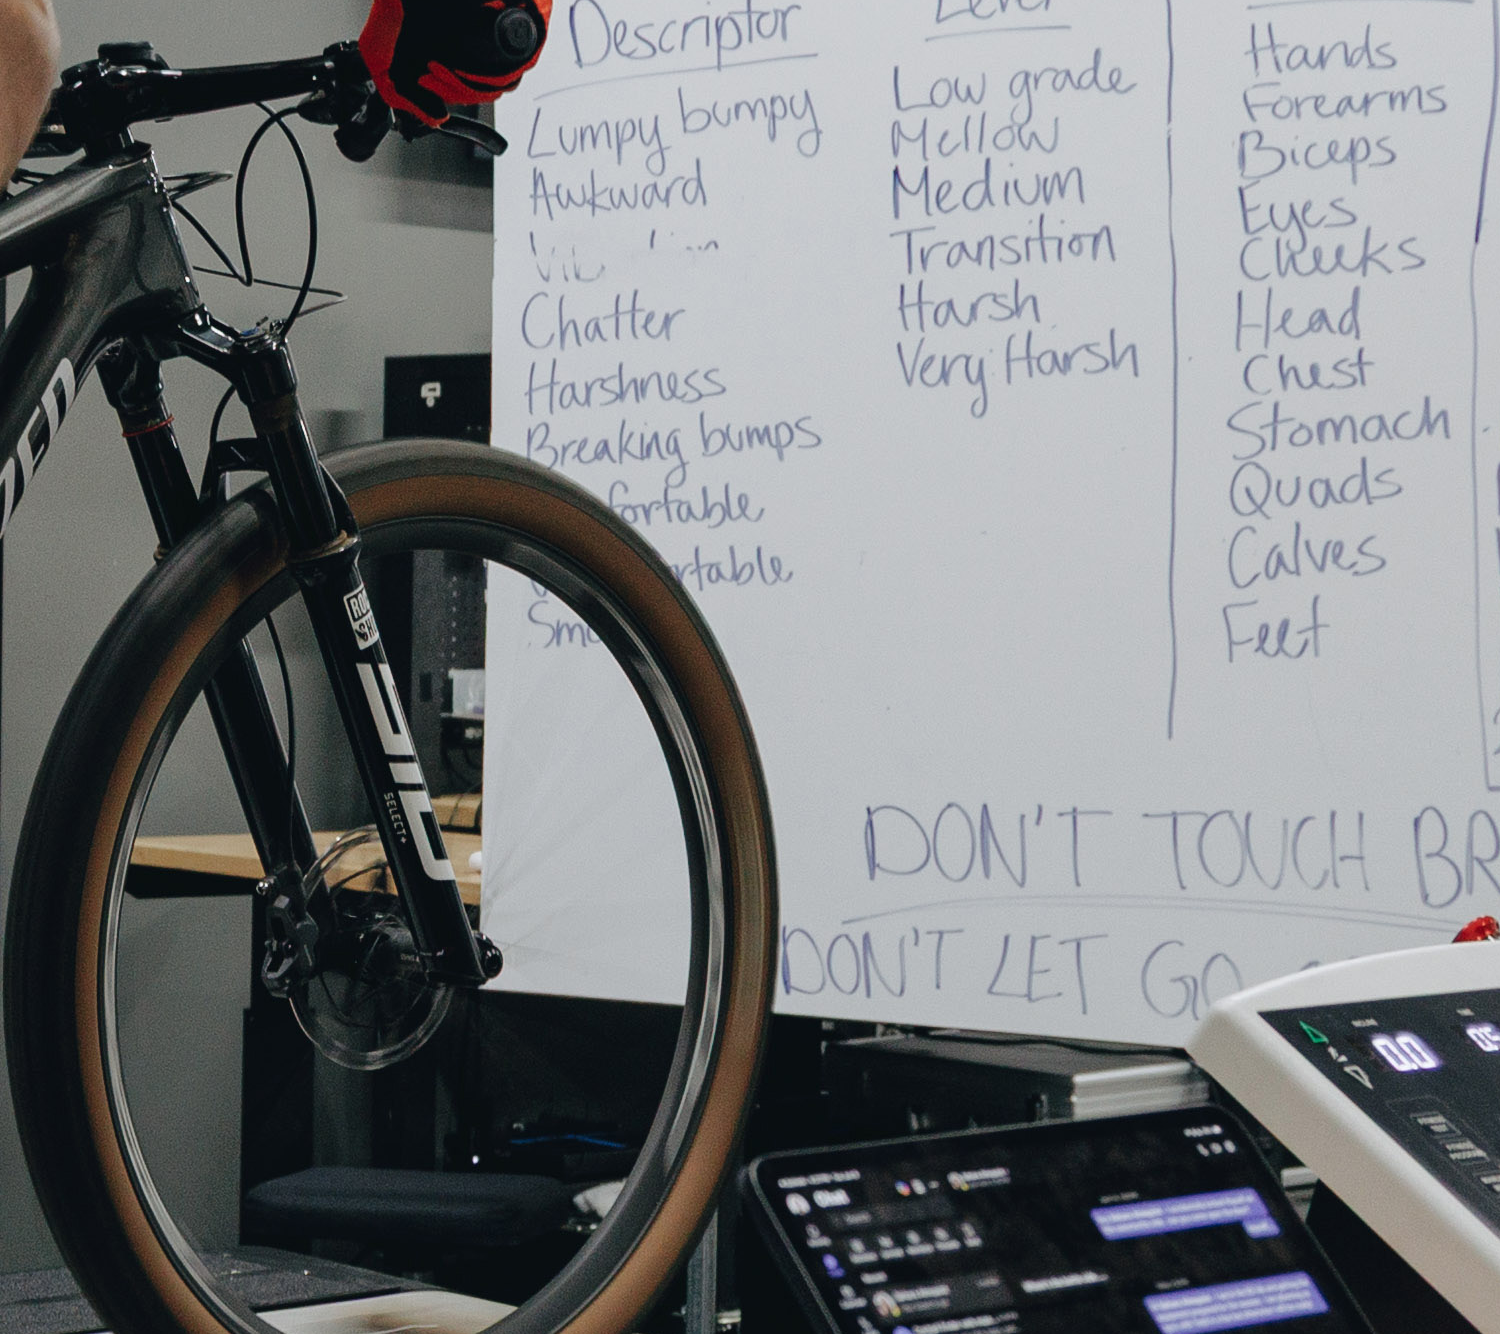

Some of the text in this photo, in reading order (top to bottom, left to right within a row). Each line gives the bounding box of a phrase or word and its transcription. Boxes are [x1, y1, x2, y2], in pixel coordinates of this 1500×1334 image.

[1244, 22, 1398, 77] Hands
[895, 48, 1138, 121] Low grade
[1243, 81, 1448, 123] Forearms
[526, 87, 823, 175] Lumpy bumpy
[891, 112, 1060, 158] Mellow
[1237, 129, 1398, 185] Biceps
[532, 159, 708, 223] Awkward
[892, 164, 1087, 219] Medium
[1238, 179, 1359, 243] Eyes
[889, 214, 1117, 275] Transition
[1239, 224, 1427, 281] Cheeks
[520, 289, 687, 351] Chatter
[898, 279, 1041, 334] Harsh
[1235, 285, 1361, 352] Head
[525, 358, 727, 416] Harshness
[897, 333, 1140, 419] Very Harsh
[1243, 346, 1375, 396] Chest
[526, 411, 822, 489] Breaking bumps
[1226, 395, 1451, 461] Stomach
[1229, 456, 1403, 520] Quads
[1229, 521, 1387, 589] Calves
[1222, 594, 1331, 662] Feet
[865, 801, 1114, 889] DON'T
[1142, 807, 1370, 893] TOUCH
[780, 925, 965, 999] DON'T
[987, 932, 1109, 1016] LET
